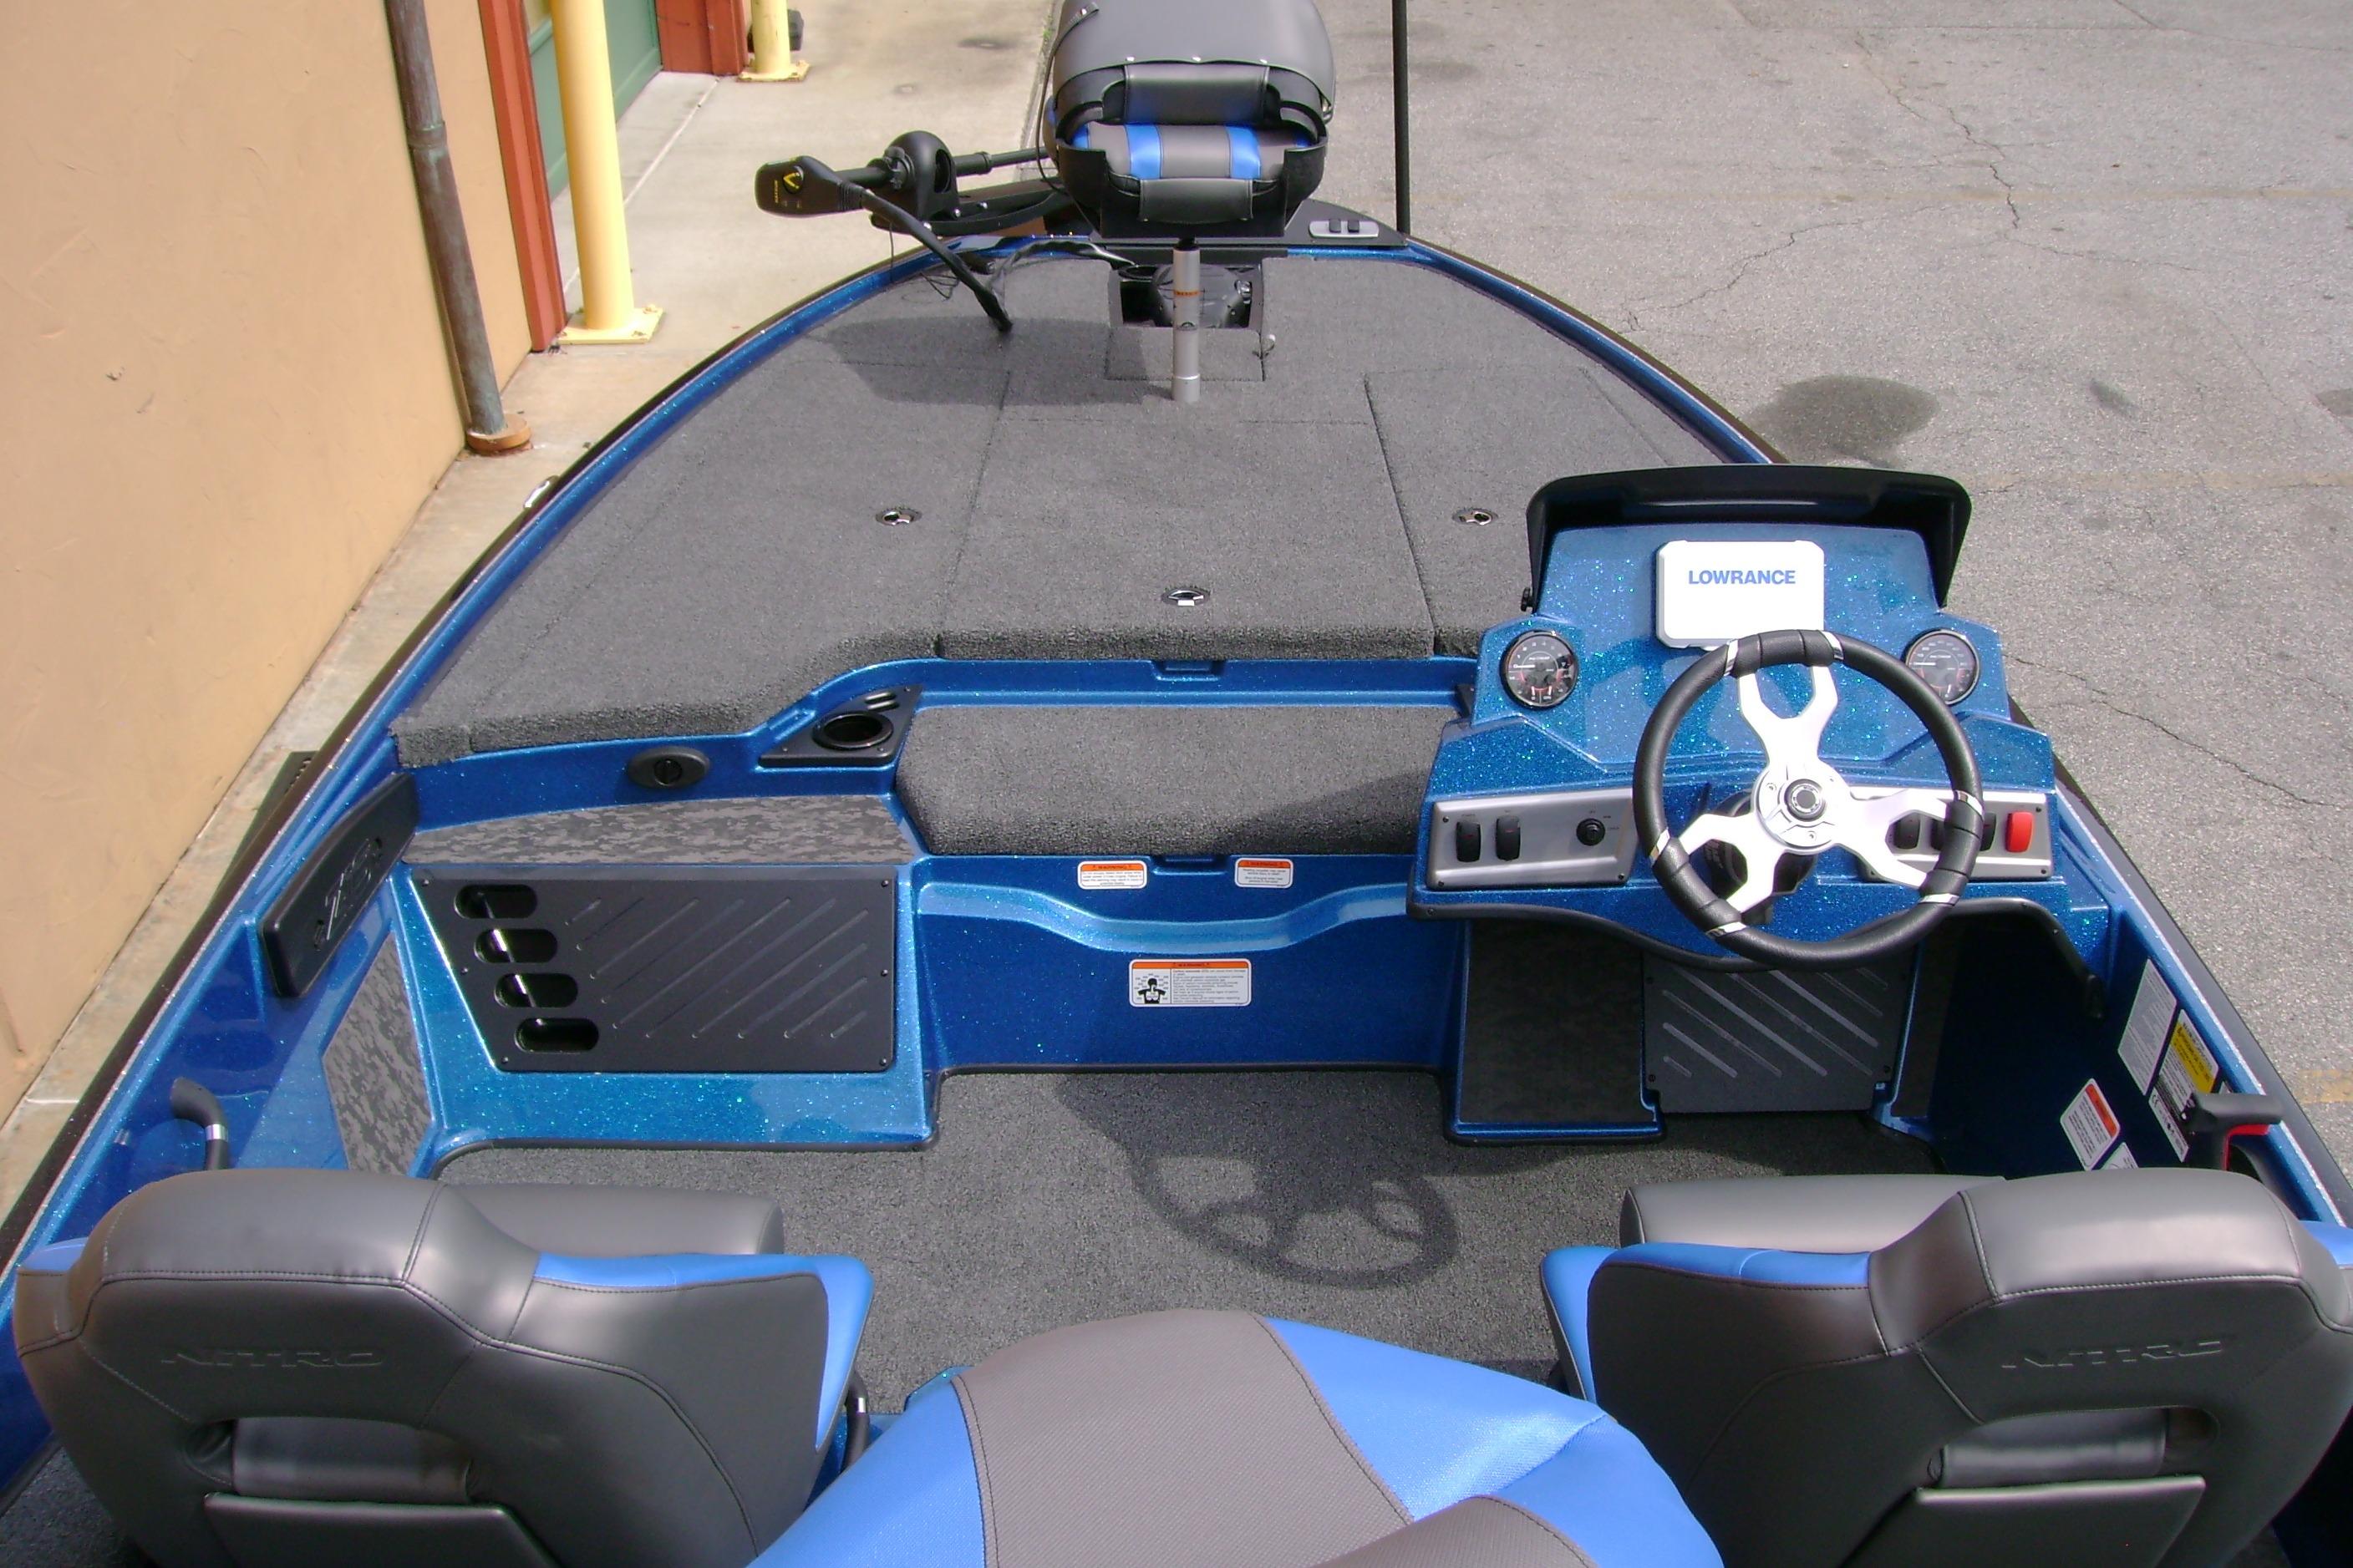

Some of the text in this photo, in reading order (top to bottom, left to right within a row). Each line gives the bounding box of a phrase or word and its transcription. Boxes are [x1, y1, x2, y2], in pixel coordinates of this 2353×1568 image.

[1688, 570, 1796, 585] LOWRANCE
[160, 1347, 385, 1367] NITRO
[2002, 1336, 2233, 1368] NITRO
